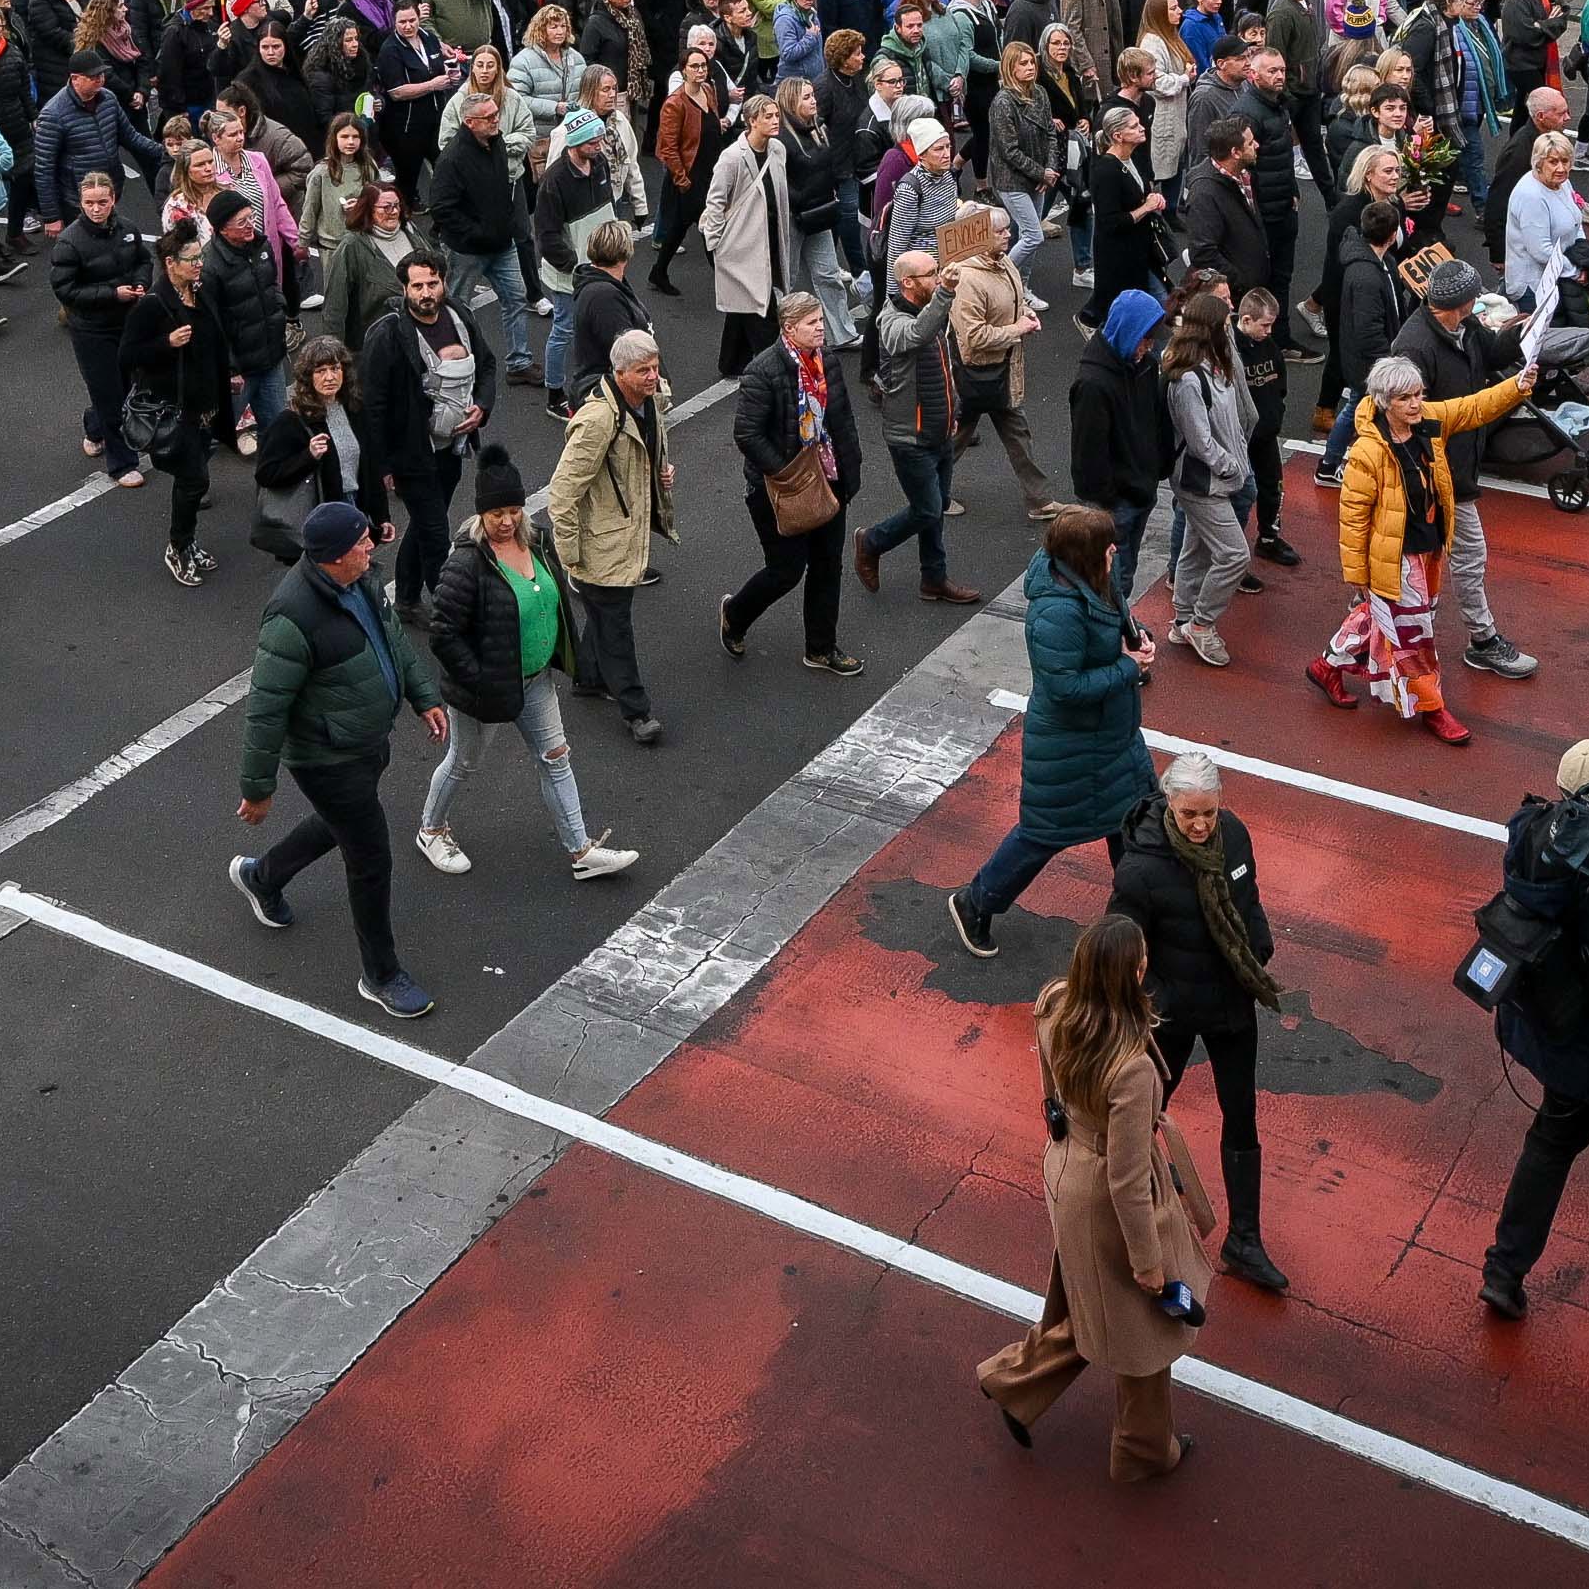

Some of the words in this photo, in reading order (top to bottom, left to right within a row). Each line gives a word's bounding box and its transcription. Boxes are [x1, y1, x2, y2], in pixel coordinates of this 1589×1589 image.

[944, 217, 989, 256] ENOUGH
[1403, 247, 1445, 285] END
[1244, 359, 1274, 377] UCCI
